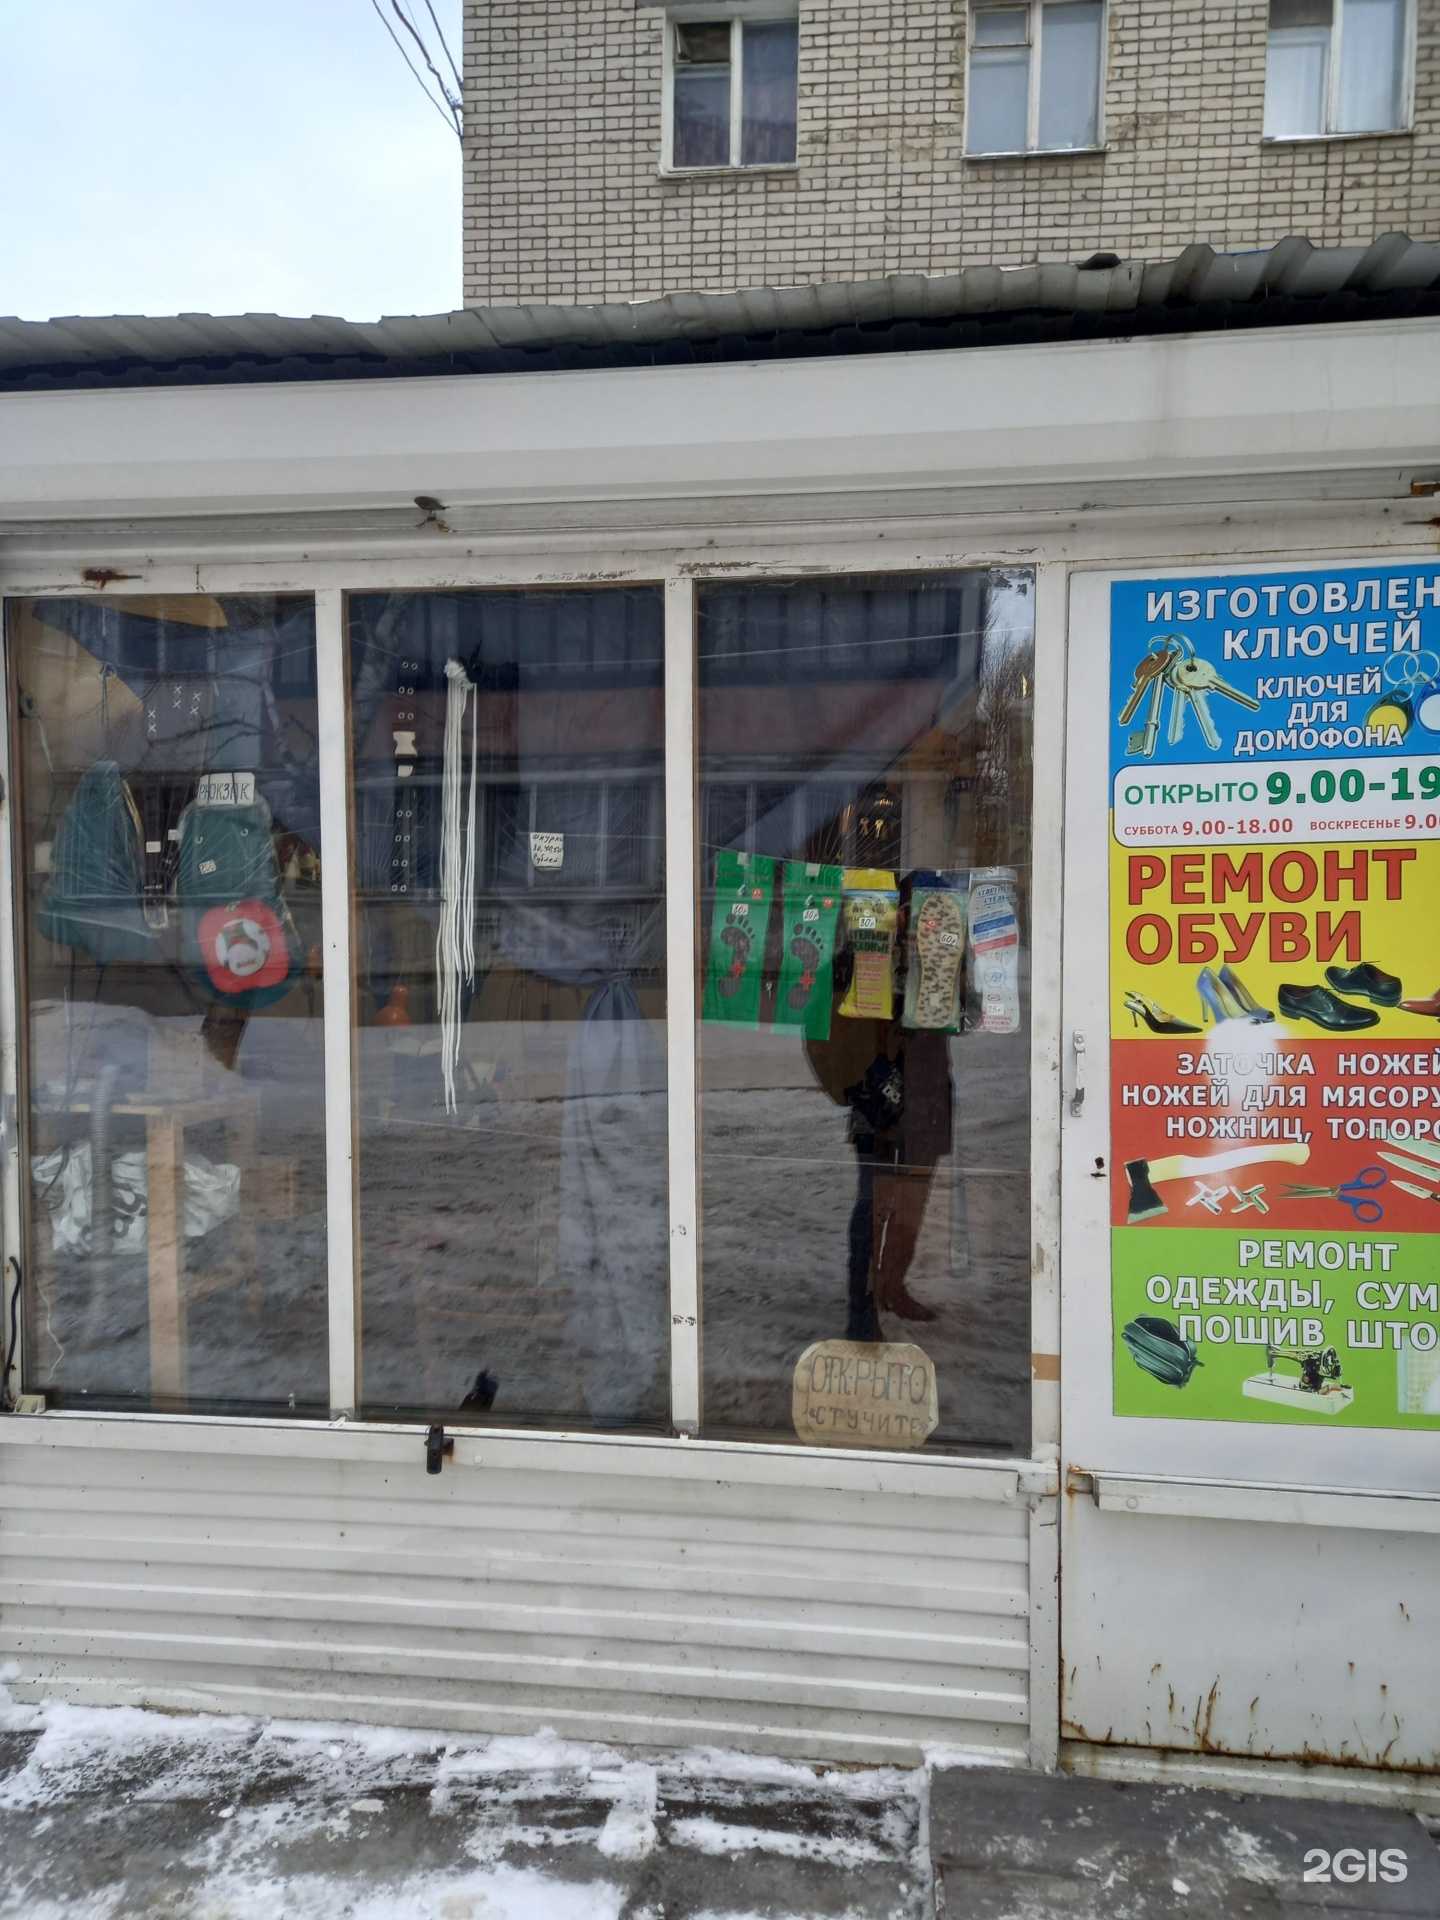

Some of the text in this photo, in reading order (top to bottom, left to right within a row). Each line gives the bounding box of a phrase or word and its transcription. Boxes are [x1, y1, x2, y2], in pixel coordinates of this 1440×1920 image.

[1146, 576, 1440, 622] ИЗГОТОВЛЕН
[1223, 610, 1421, 661] КЛЮЧЕЙ
[1256, 666, 1381, 699] КЛЮЧЕЙ
[1287, 700, 1348, 728] ДЛЯ
[1233, 724, 1404, 757] ДОМОФОНА
[1123, 765, 1440, 806] ОТКРЫТО 9.00-19
[1123, 813, 1440, 836] СУББОТА 9.00-18.00 ВОСКРЕСЕНЬЕ 9.0
[1128, 848, 1417, 905] РЕМОНТ
[1126, 911, 1361, 965] ОБУВИ
[1176, 1053, 1315, 1076] ЗАТОЧКА
[1122, 1080, 1230, 1107] НОЖЕЙ
[1242, 1086, 1306, 1111] ДЛЯ
[1166, 1116, 1313, 1143] НОЖНИЦ,
[1238, 1239, 1399, 1271] РЕМОНТ
[1146, 1275, 1439, 1314] ОДЕЖДЫ, СУМ
[1179, 1314, 1439, 1351] ПОШИВ ШТО
[811, 1354, 927, 1404] ОТКРЫТО
